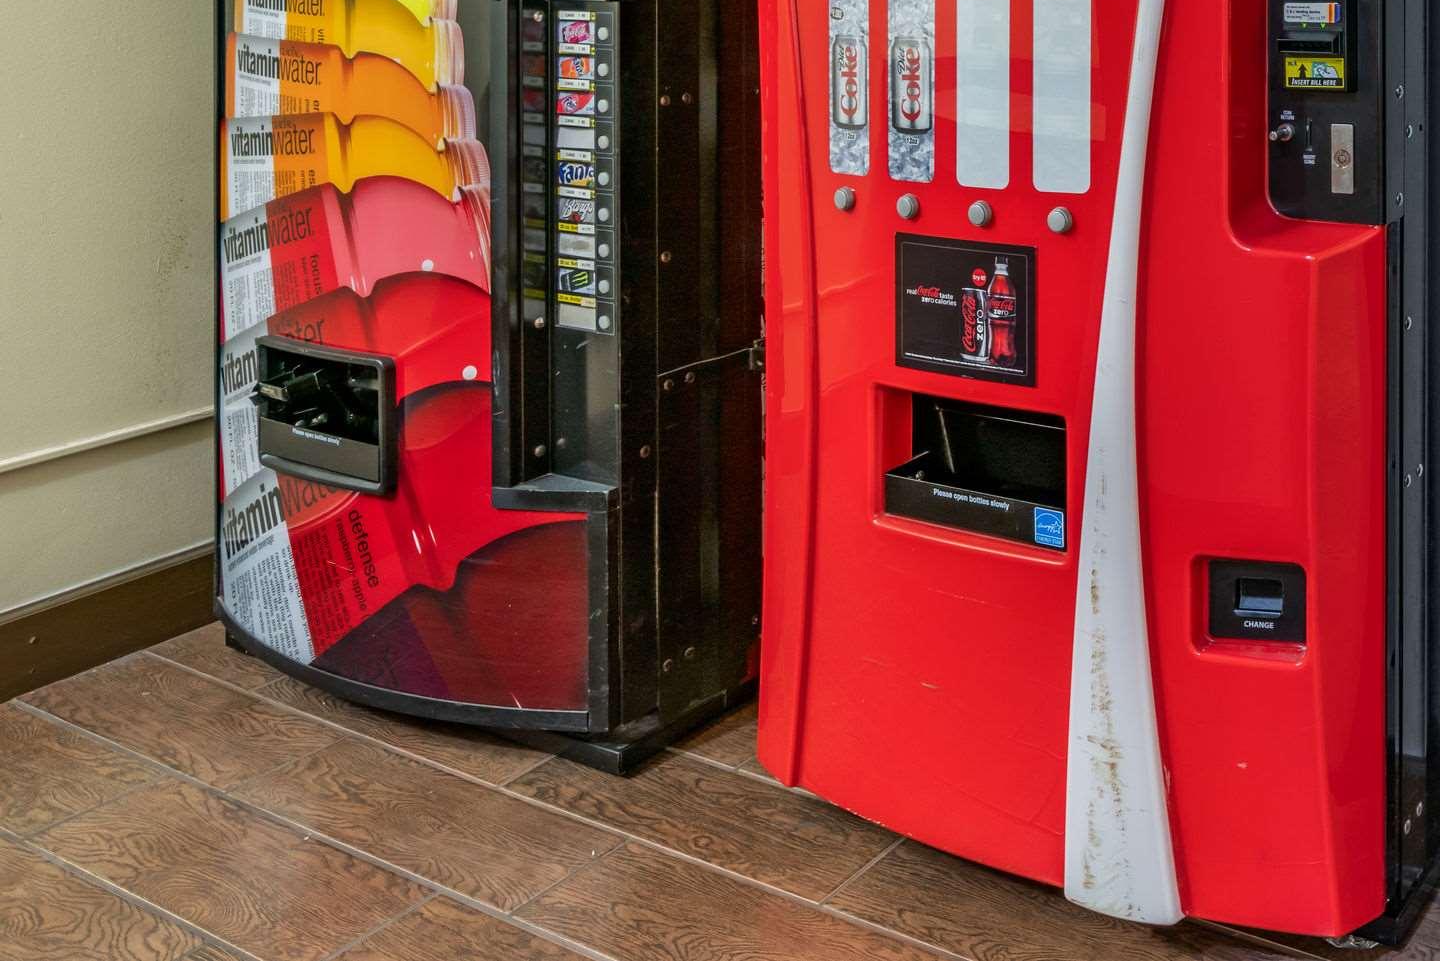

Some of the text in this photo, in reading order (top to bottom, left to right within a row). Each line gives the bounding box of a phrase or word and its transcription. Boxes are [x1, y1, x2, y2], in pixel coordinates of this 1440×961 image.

[238, 44, 321, 86] vitaminwater
[841, 47, 858, 118] Coke
[902, 47, 921, 121] Coke
[1292, 78, 1309, 86] INSERT
[231, 125, 315, 156] vitaminwater
[224, 207, 312, 263] vitaminwater
[935, 298, 957, 306] calories
[976, 309, 984, 340] zero
[933, 488, 1010, 510] Please open bottles slowly
[349, 508, 380, 588] defense
[1244, 620, 1274, 629] CHANGE
